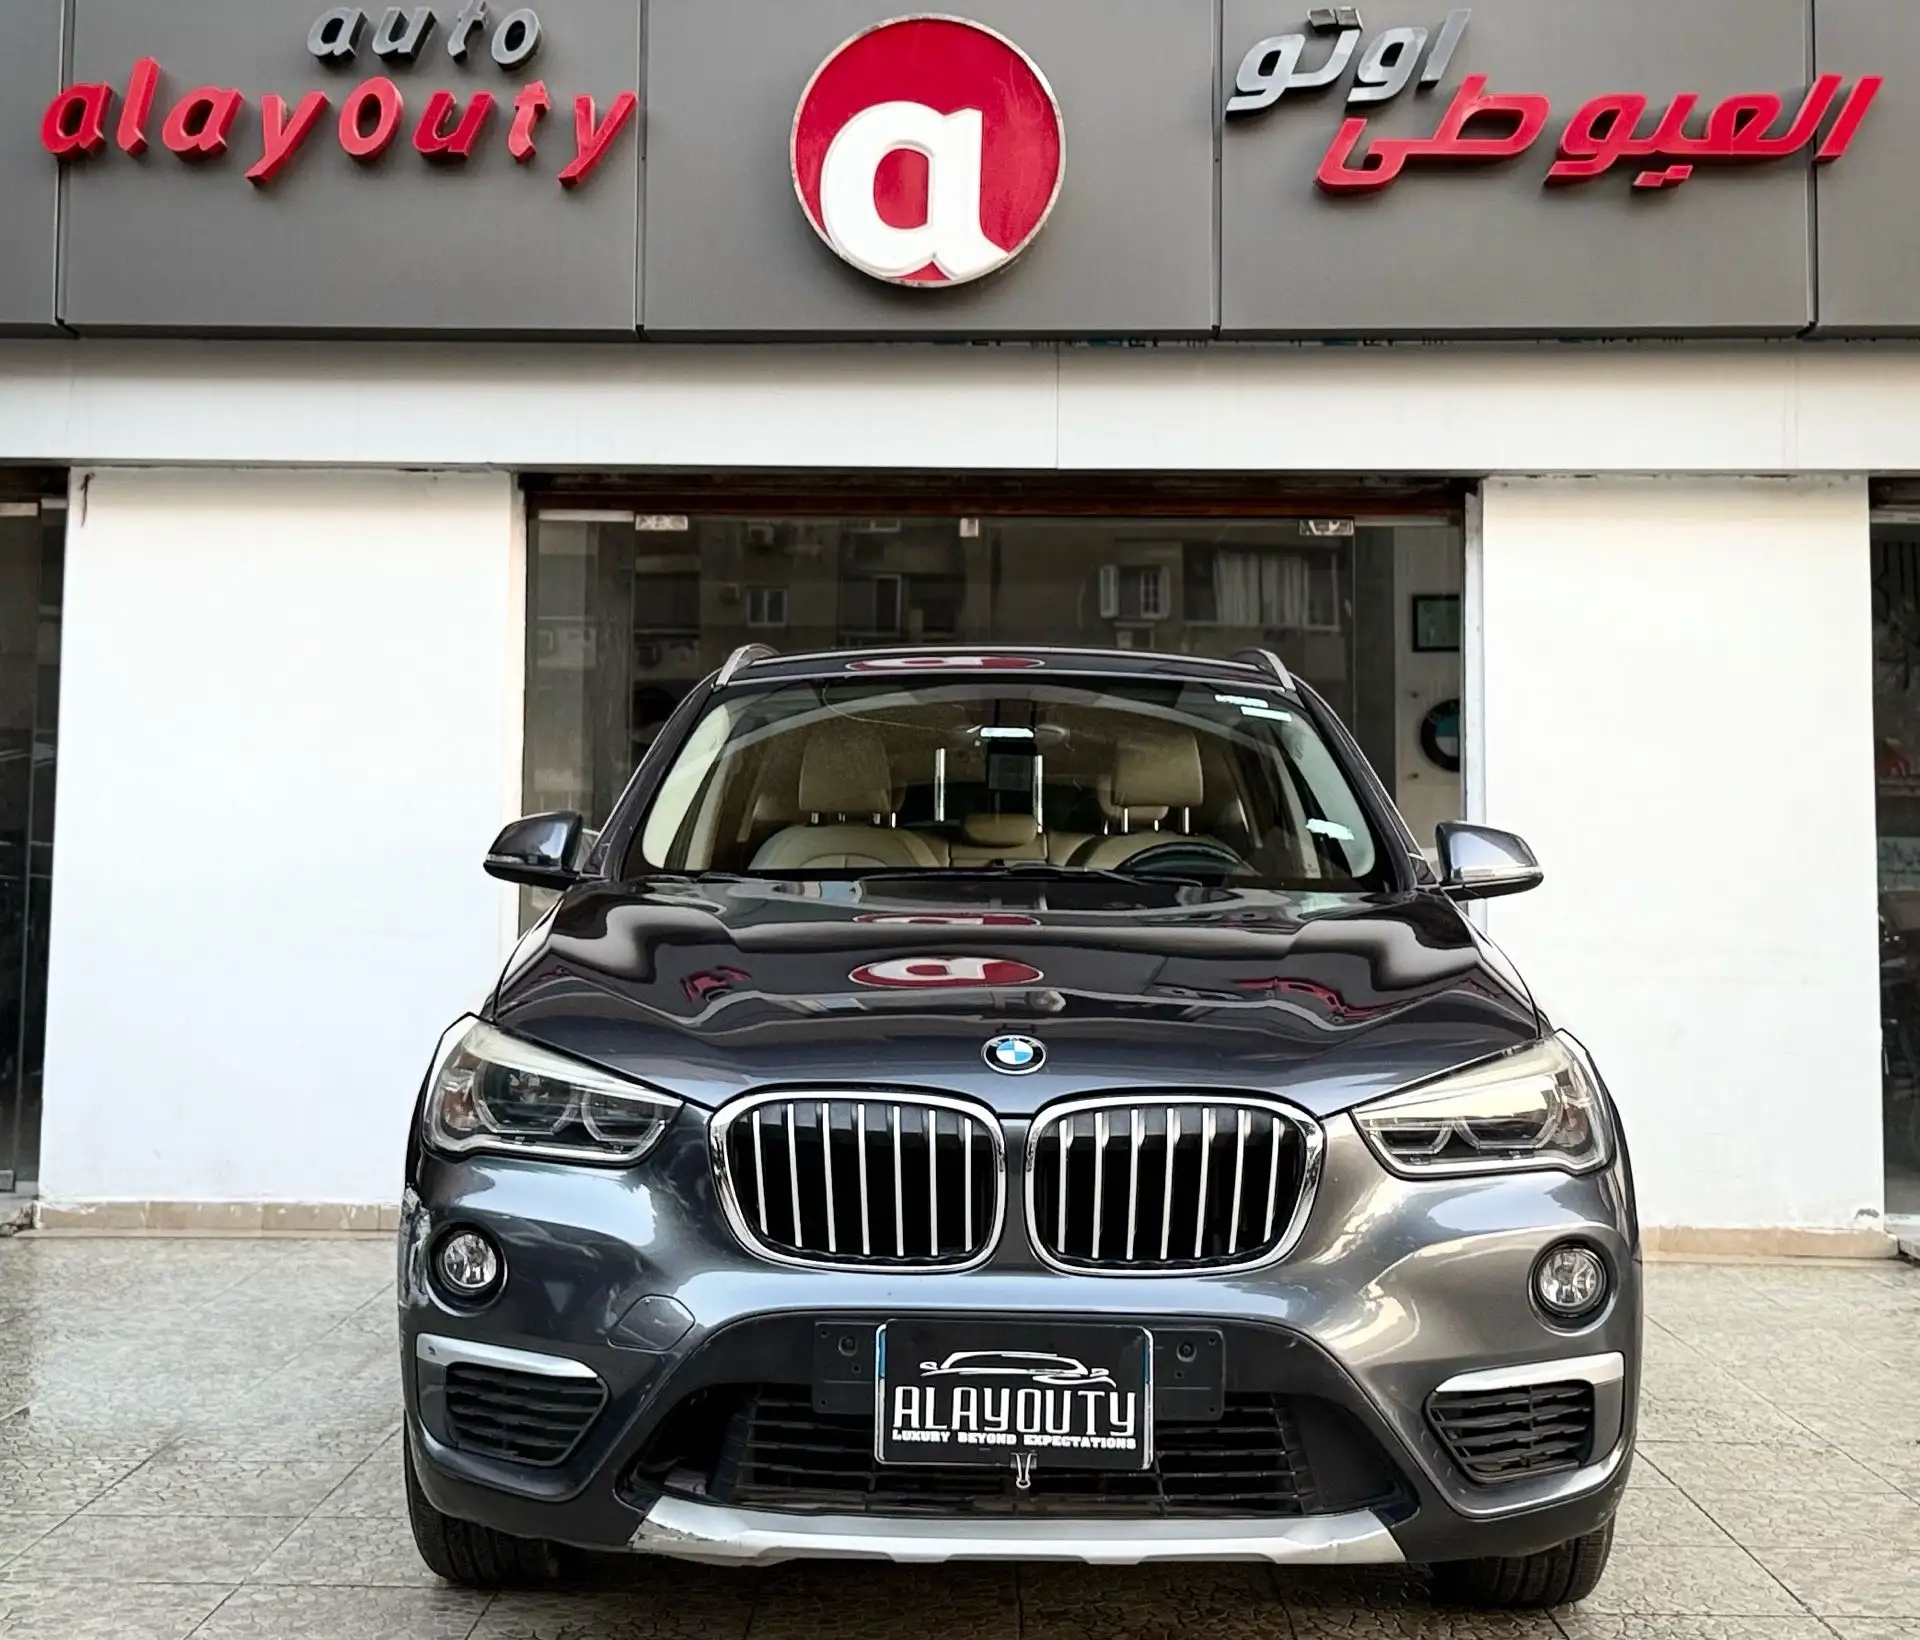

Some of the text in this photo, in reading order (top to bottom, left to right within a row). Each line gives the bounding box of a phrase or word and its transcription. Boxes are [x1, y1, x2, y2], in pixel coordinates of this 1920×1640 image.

[306, 0, 543, 70] auto
[1225, 6, 1471, 118] اوتو
[41, 56, 638, 188] alayouty
[819, 100, 1009, 280] a
[892, 1386, 1136, 1436] ALAYOUTY
[892, 1430, 1137, 1450] LUXURY BEYOND EXPECTATIONS
